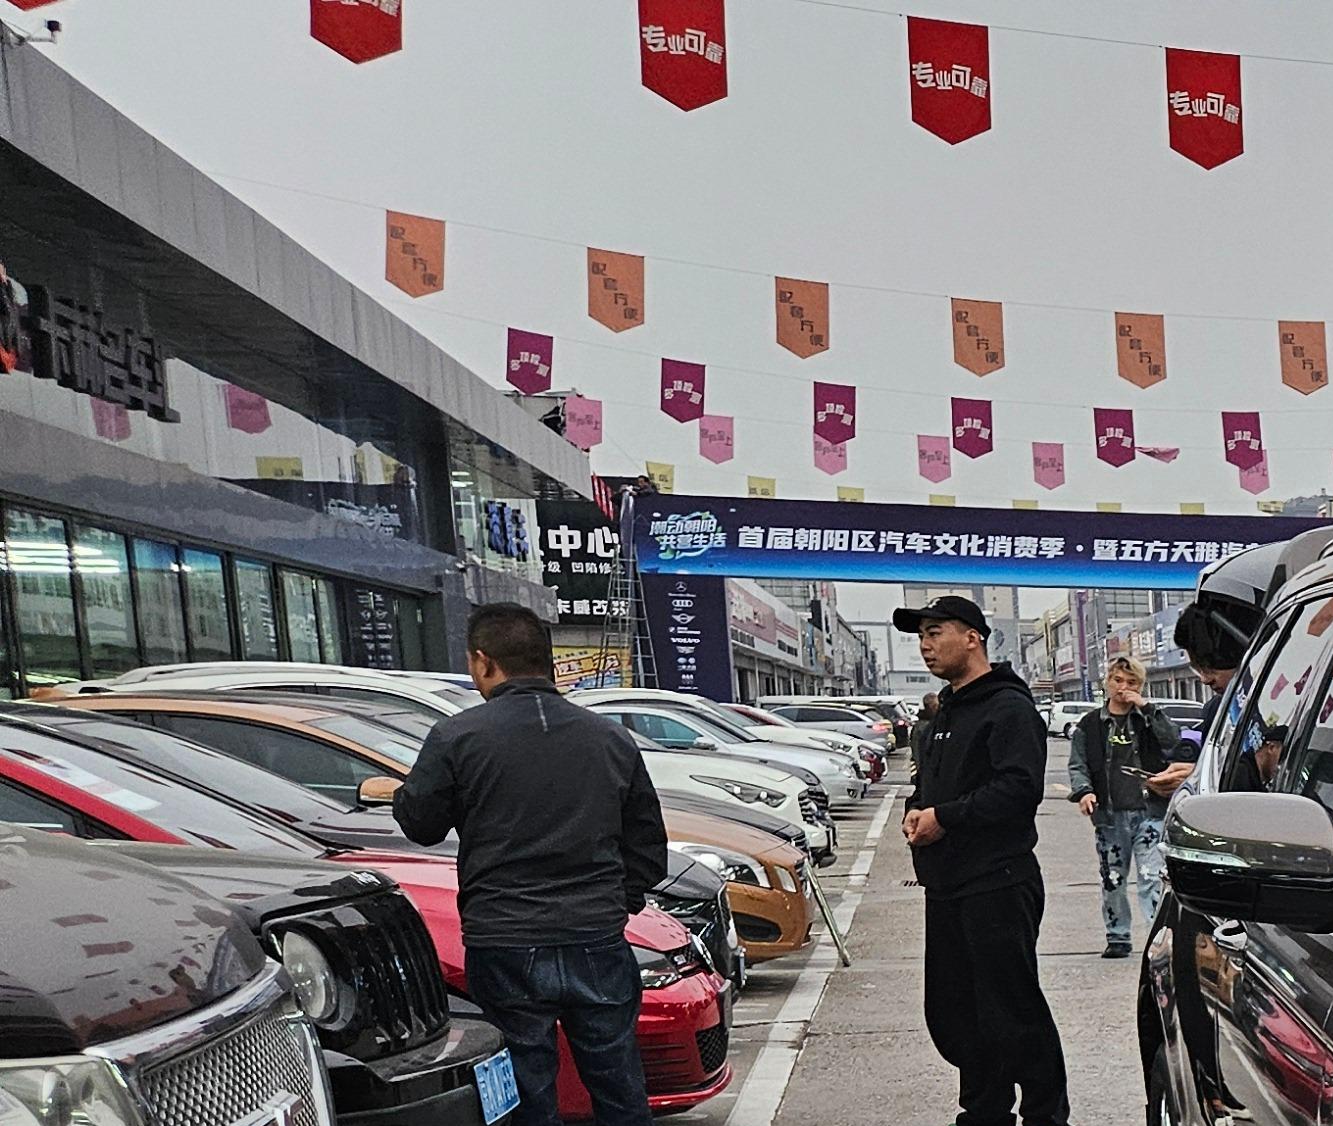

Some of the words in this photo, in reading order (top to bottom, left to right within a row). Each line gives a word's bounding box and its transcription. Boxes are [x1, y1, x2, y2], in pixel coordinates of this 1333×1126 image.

[642, 24, 726, 65] 专业可靠
[912, 61, 989, 99] 专业可靠
[1169, 92, 1240, 124] 专业可靠
[539, 525, 621, 558] 中心
